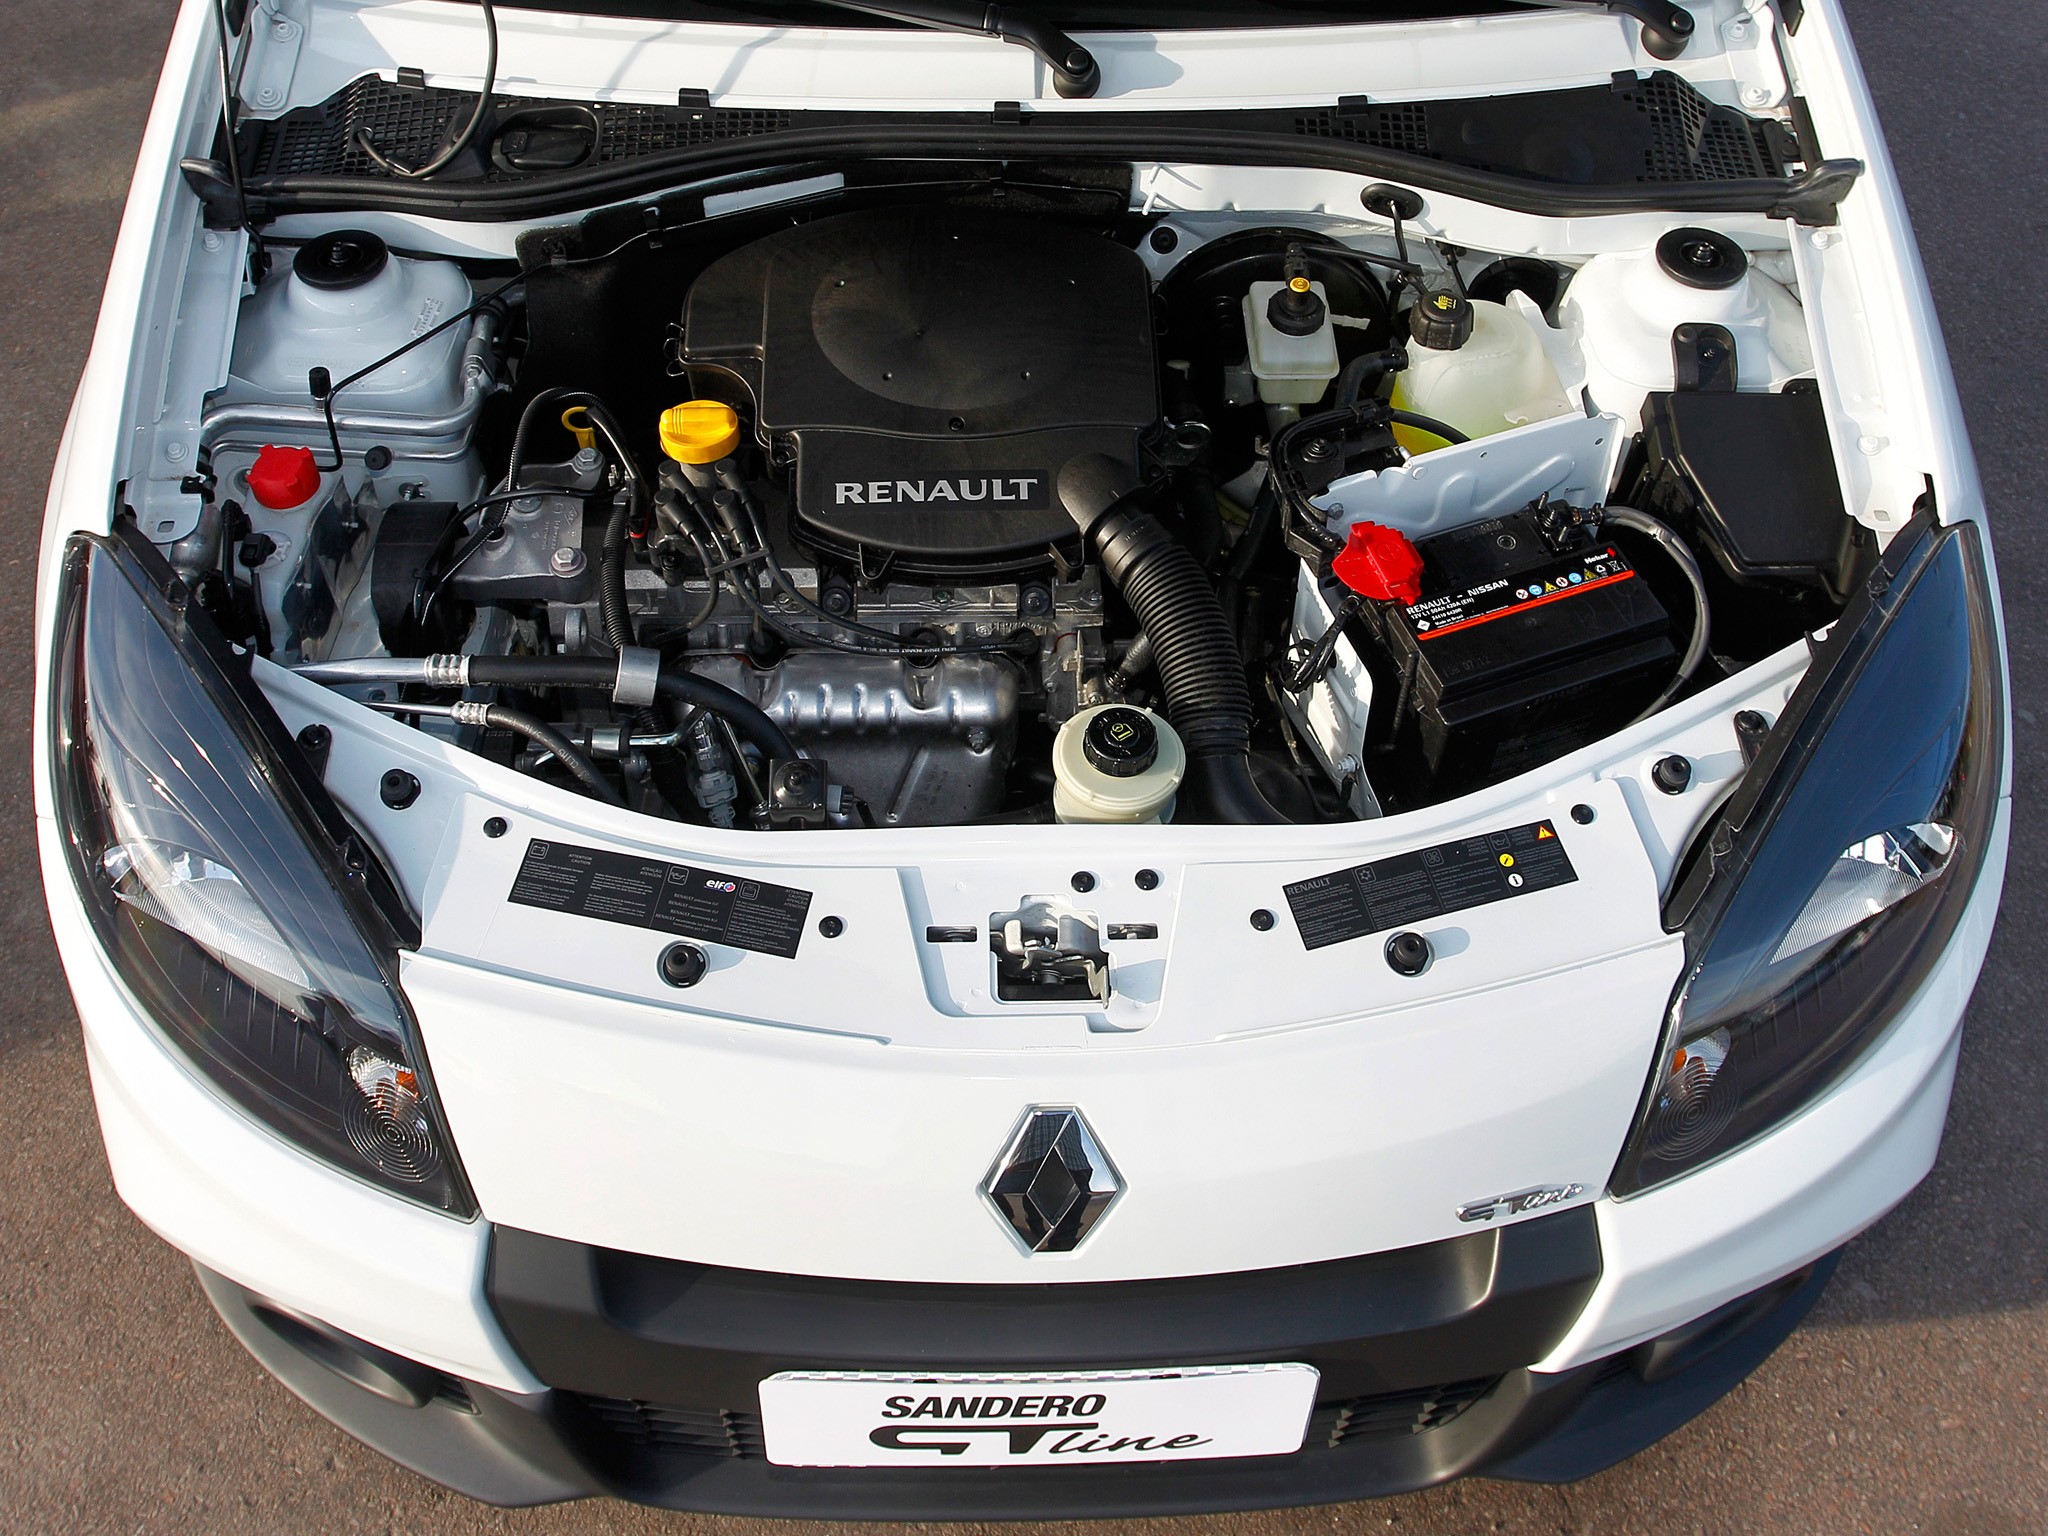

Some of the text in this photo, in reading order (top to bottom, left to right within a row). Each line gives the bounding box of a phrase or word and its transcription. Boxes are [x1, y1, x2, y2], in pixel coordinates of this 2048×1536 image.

[835, 478, 1038, 505] RENAULT
[1406, 596, 1451, 615] RENAULT
[1467, 579, 1509, 597] NISSAN
[706, 880, 726, 890] elf
[1286, 877, 1331, 896] RENAULT
[674, 893, 694, 901] RENAULT
[668, 900, 688, 908] RENAULT
[655, 913, 675, 921] RENAULT
[670, 909, 691, 917] RENAULT
[881, 1394, 1107, 1418] SANDERO
